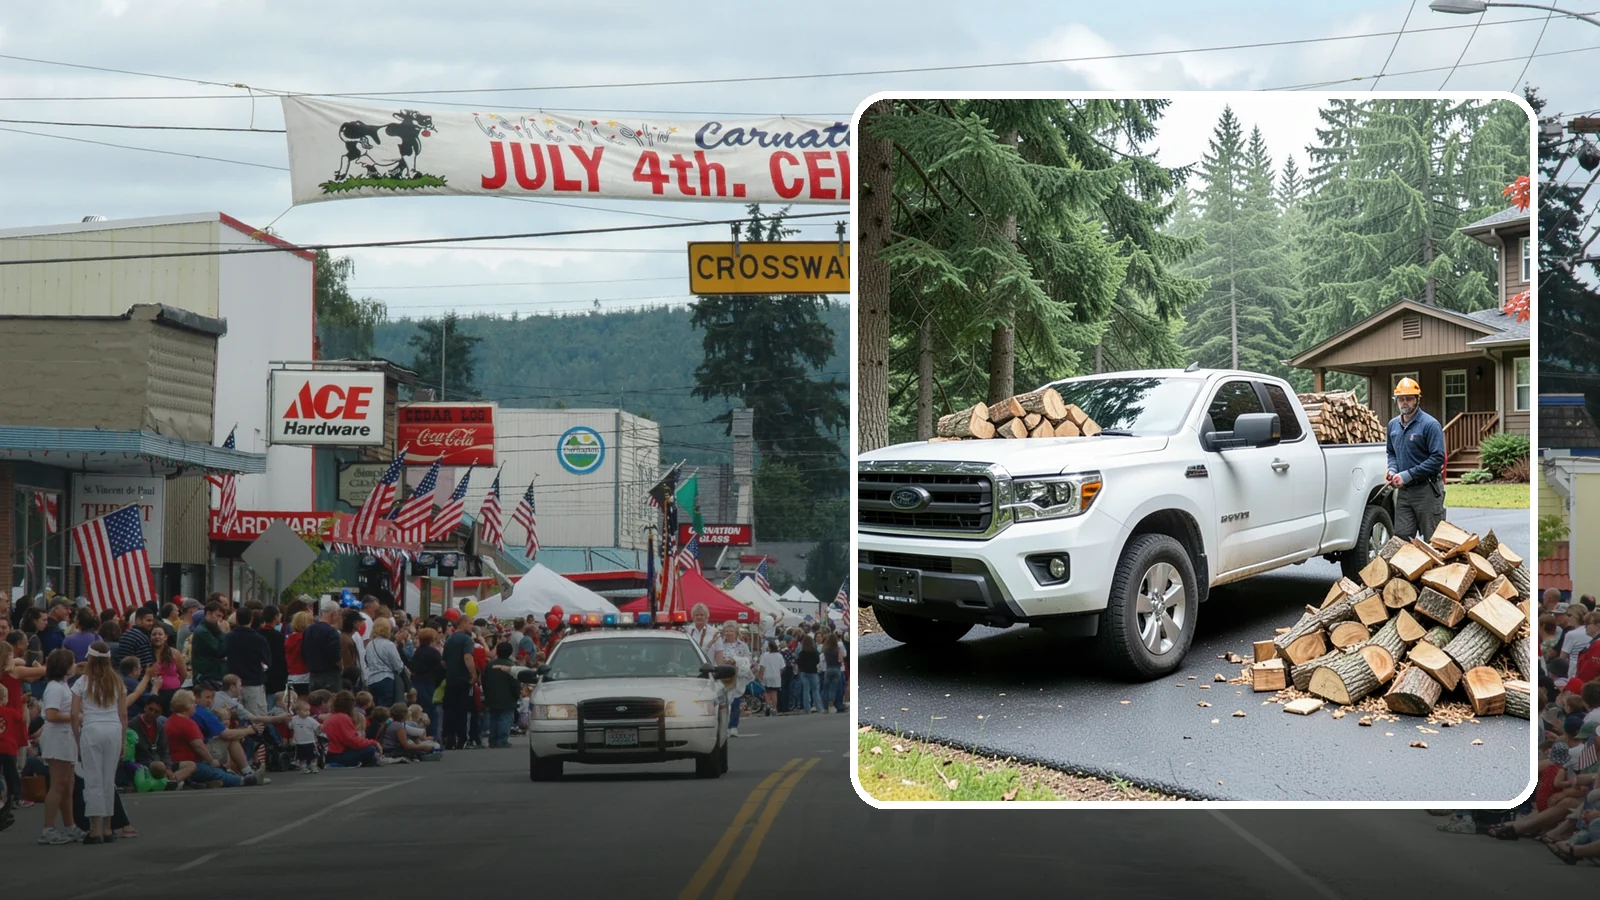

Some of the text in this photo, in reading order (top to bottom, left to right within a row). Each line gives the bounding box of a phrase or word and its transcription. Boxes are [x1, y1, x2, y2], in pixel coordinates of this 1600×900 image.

[481, 141, 604, 192] JULY
[632, 150, 746, 197] 4th.
[697, 254, 850, 280] CROSSWA
[282, 380, 373, 419] ACE
[405, 409, 485, 422] CEDAR LOG
[283, 421, 370, 436] Hardware
[416, 428, 476, 447] Coca-Cola
[353, 467, 387, 480] Simpl
[83, 485, 155, 495] St. Vincent de Paul
[81, 503, 154, 522] THT
[213, 516, 330, 535] HARDARE
[688, 527, 741, 535] CRNATION
[699, 535, 730, 543] GLASS
